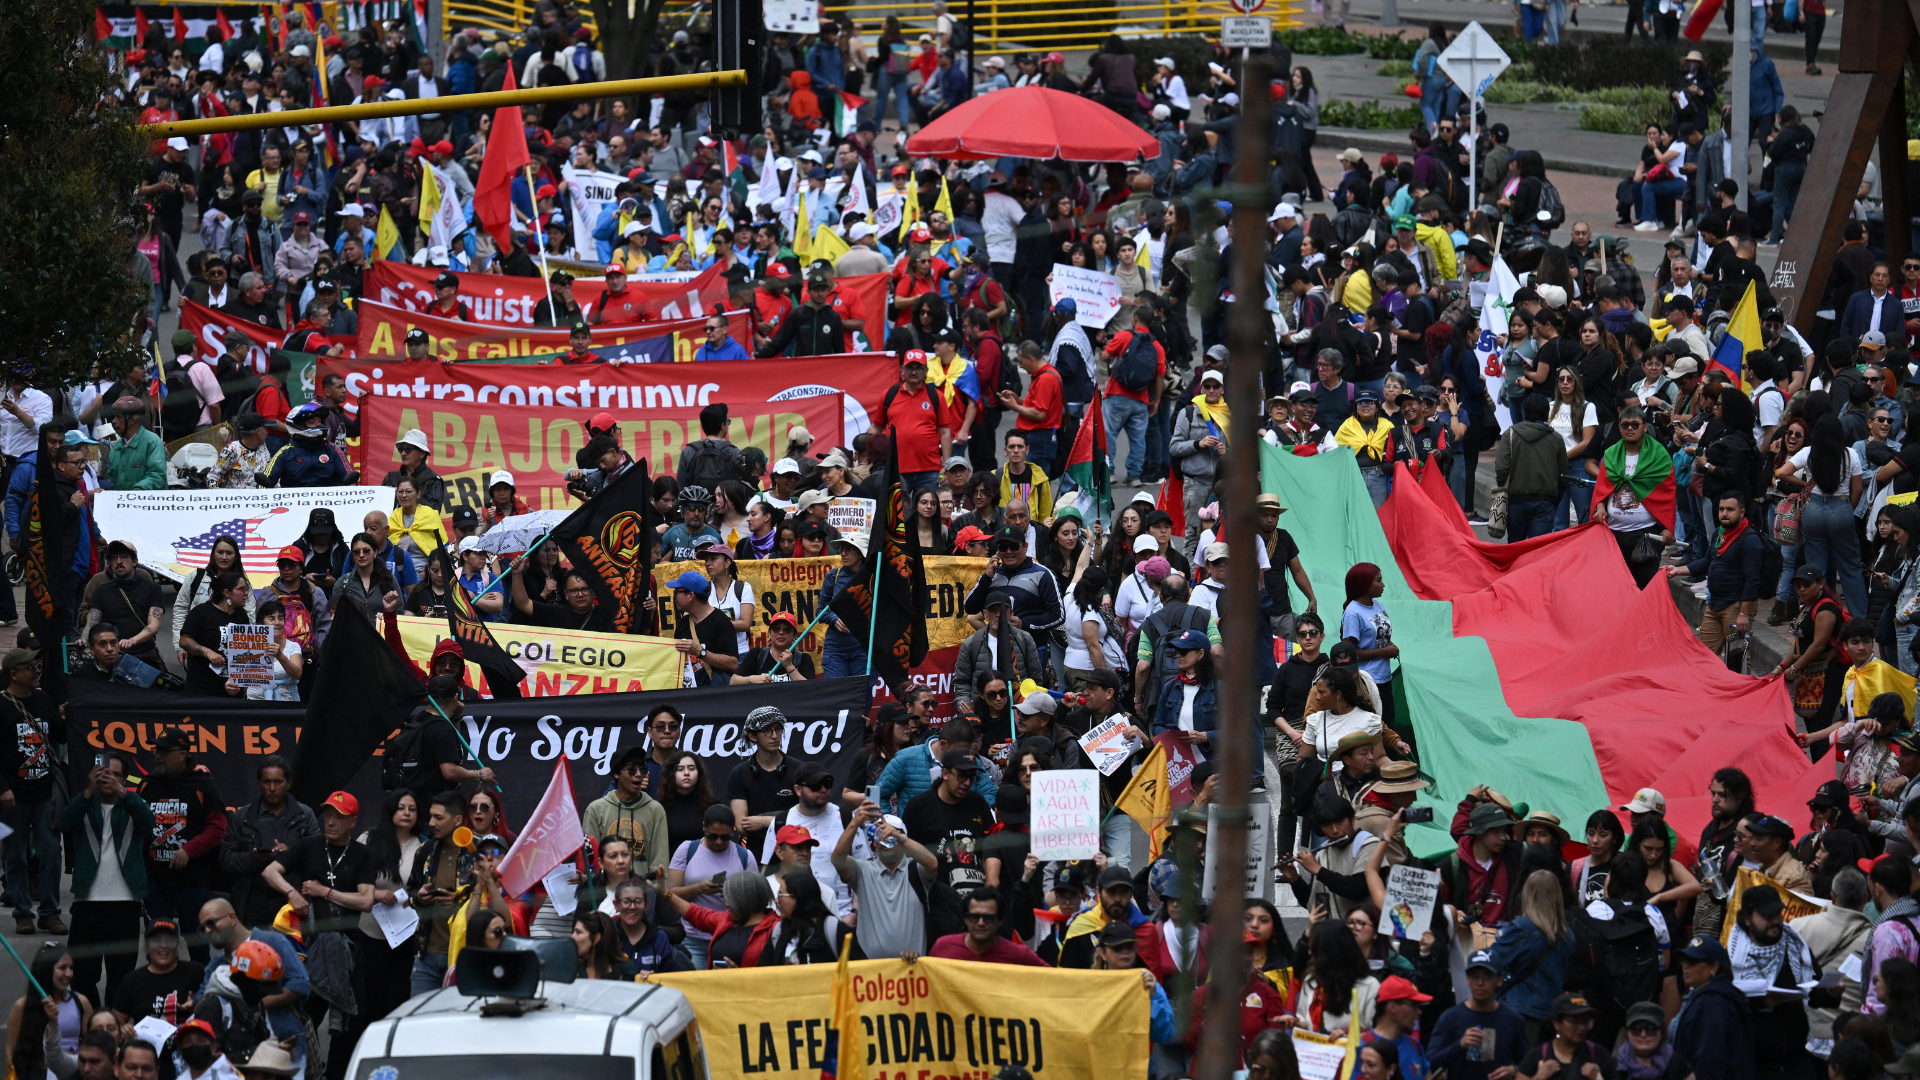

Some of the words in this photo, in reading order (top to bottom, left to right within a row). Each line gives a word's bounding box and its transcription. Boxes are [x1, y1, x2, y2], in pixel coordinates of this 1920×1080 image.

[392, 408, 584, 475] ABAJO
[618, 412, 808, 475] TRMP
[189, 494, 208, 502] las
[273, 489, 375, 500] generaciones
[314, 496, 374, 505] nación?
[829, 508, 864, 517] PRIMERO
[842, 516, 864, 526] NIÑAS
[769, 561, 833, 585] Colegio
[924, 582, 965, 619] ED)
[233, 634, 268, 642] BONOS
[247, 626, 253, 634] A
[255, 626, 269, 635] LOS
[506, 640, 626, 668] COLEGIO
[1103, 719, 1116, 731] LOS
[87, 716, 227, 754] ¿QUÉN
[243, 725, 280, 755] ES
[459, 714, 516, 761] Yo
[530, 714, 621, 776] Soy
[1039, 779, 1077, 793] VIDA
[1046, 795, 1089, 811] AGUA
[1038, 814, 1085, 830] ARTE
[1035, 832, 1100, 849] LIBERTAD
[853, 970, 930, 1007] Colegio
[738, 1022, 780, 1074] LA
[786, 1012, 956, 1071] FECIDAD
[965, 1013, 1043, 1072] (IED)
